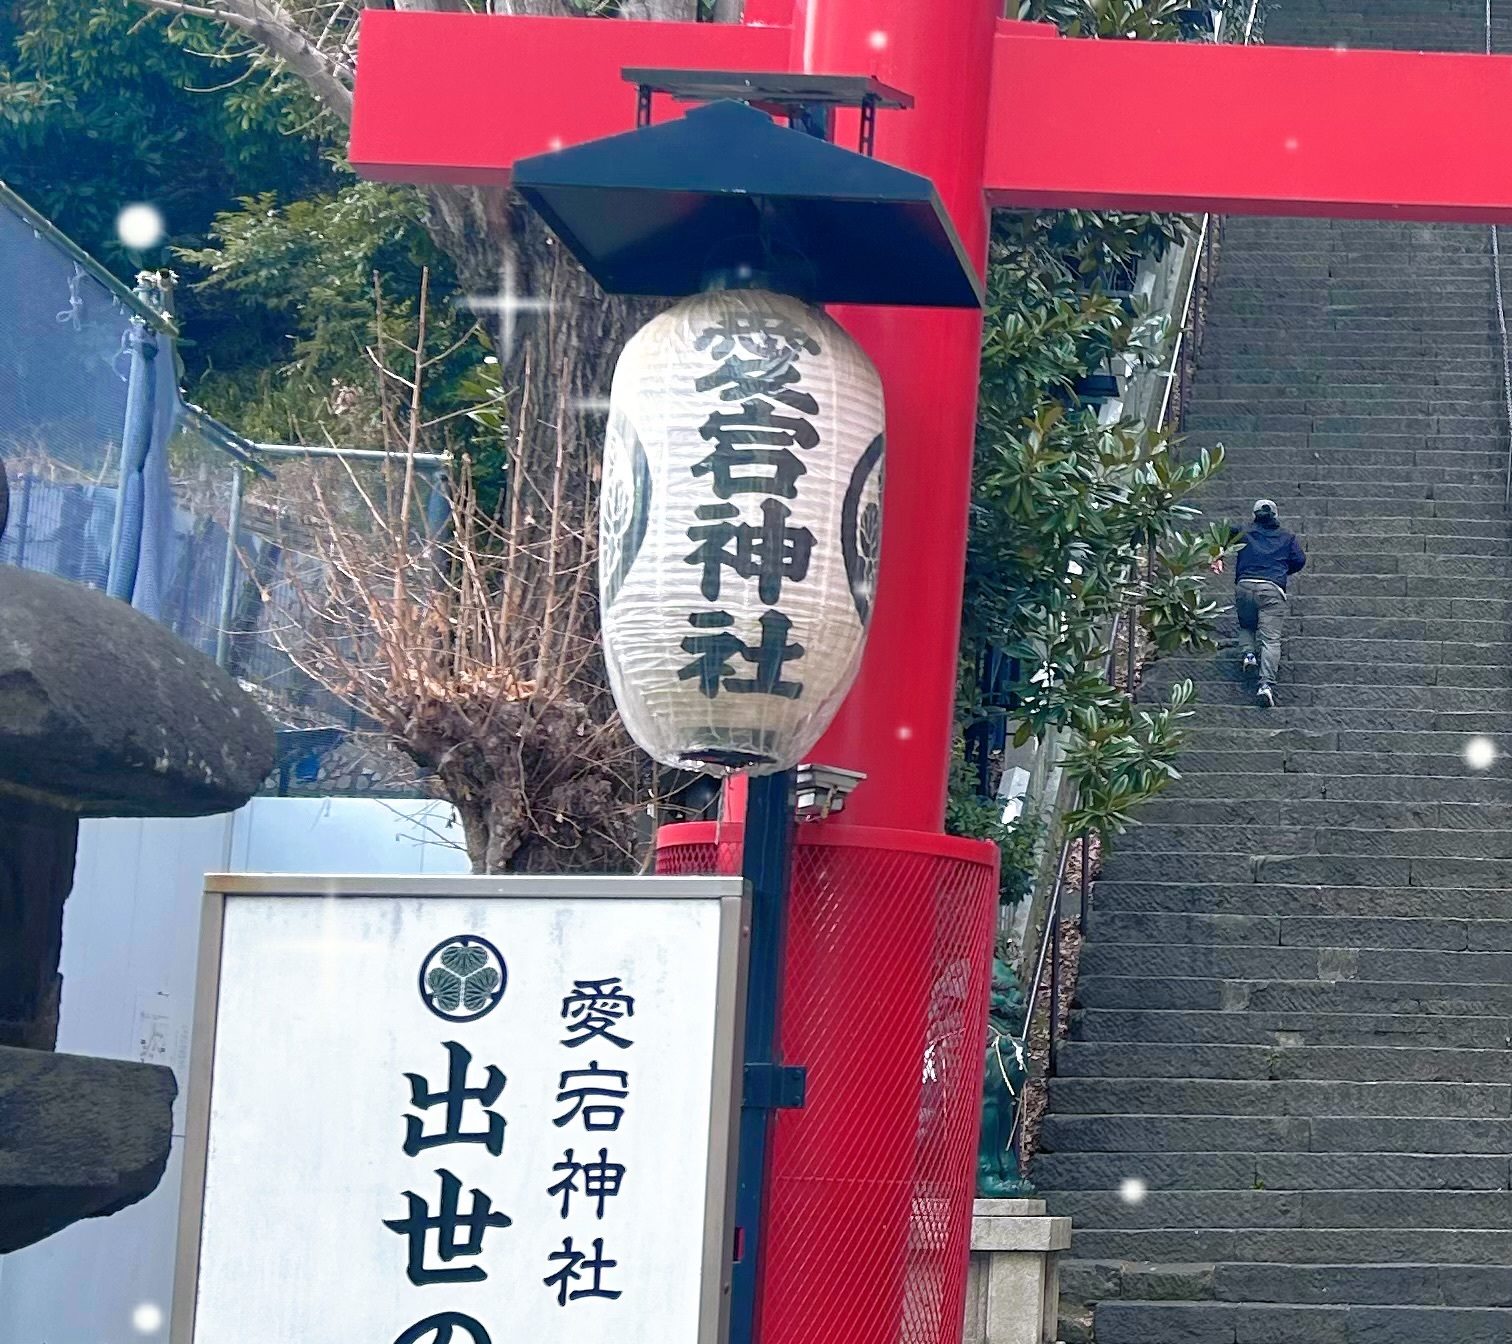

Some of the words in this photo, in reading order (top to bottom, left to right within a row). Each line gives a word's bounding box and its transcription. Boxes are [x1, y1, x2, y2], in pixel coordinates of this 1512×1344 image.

[679, 316, 820, 699] 愛宕神社
[543, 977, 635, 1307] 愛宕神社
